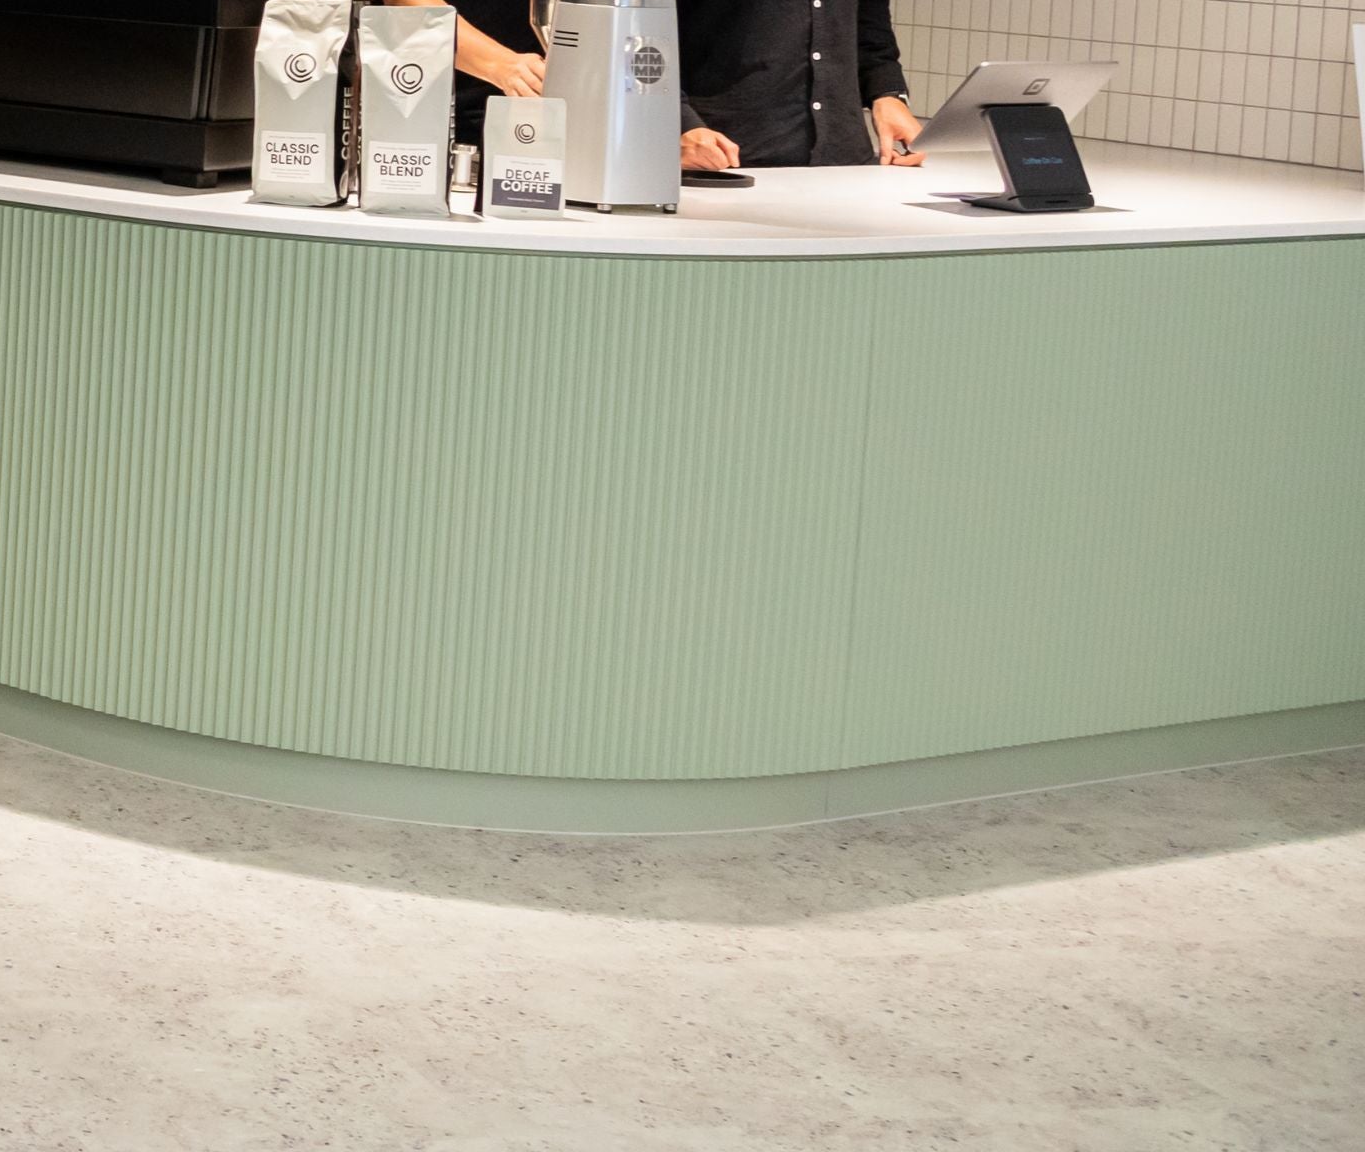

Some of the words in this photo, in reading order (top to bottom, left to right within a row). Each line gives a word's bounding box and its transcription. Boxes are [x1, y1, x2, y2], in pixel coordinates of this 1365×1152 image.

[266, 142, 320, 154] CLASSIC
[271, 154, 312, 166] BLEND
[373, 153, 431, 166] CLASSIC
[380, 165, 424, 177] BLEND
[505, 168, 550, 181] DECAF
[500, 180, 553, 195] COFFEE
